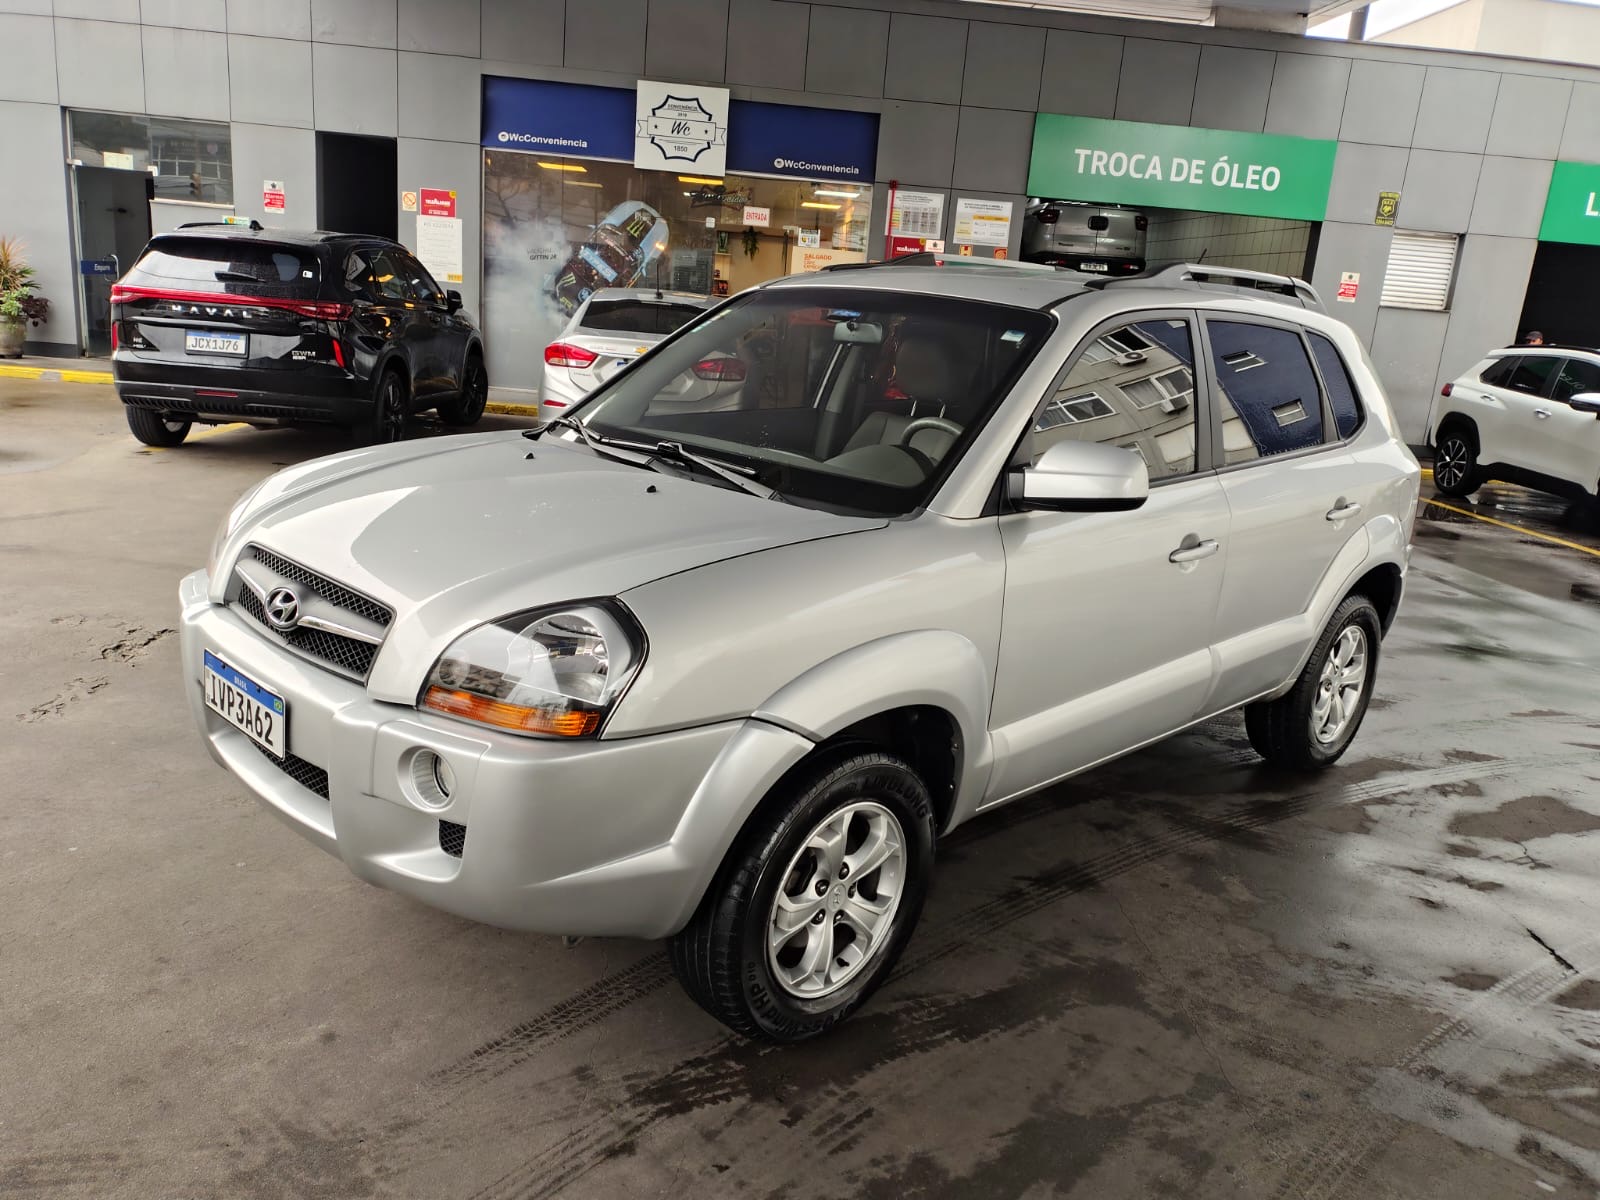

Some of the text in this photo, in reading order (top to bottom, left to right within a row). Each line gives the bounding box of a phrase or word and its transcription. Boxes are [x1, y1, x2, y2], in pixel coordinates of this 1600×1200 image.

[671, 120, 691, 136] Wc
[508, 132, 588, 148] WcConveniencia
[784, 159, 859, 175] WcConveniencia
[1074, 148, 1281, 192] TROCA DE ÓLEO
[745, 210, 768, 222] ENTRADA
[804, 253, 832, 261] SALGADO
[172, 304, 253, 319] HAVAL
[190, 336, 240, 351] JCX1J76
[210, 673, 274, 747] IVP3A62
